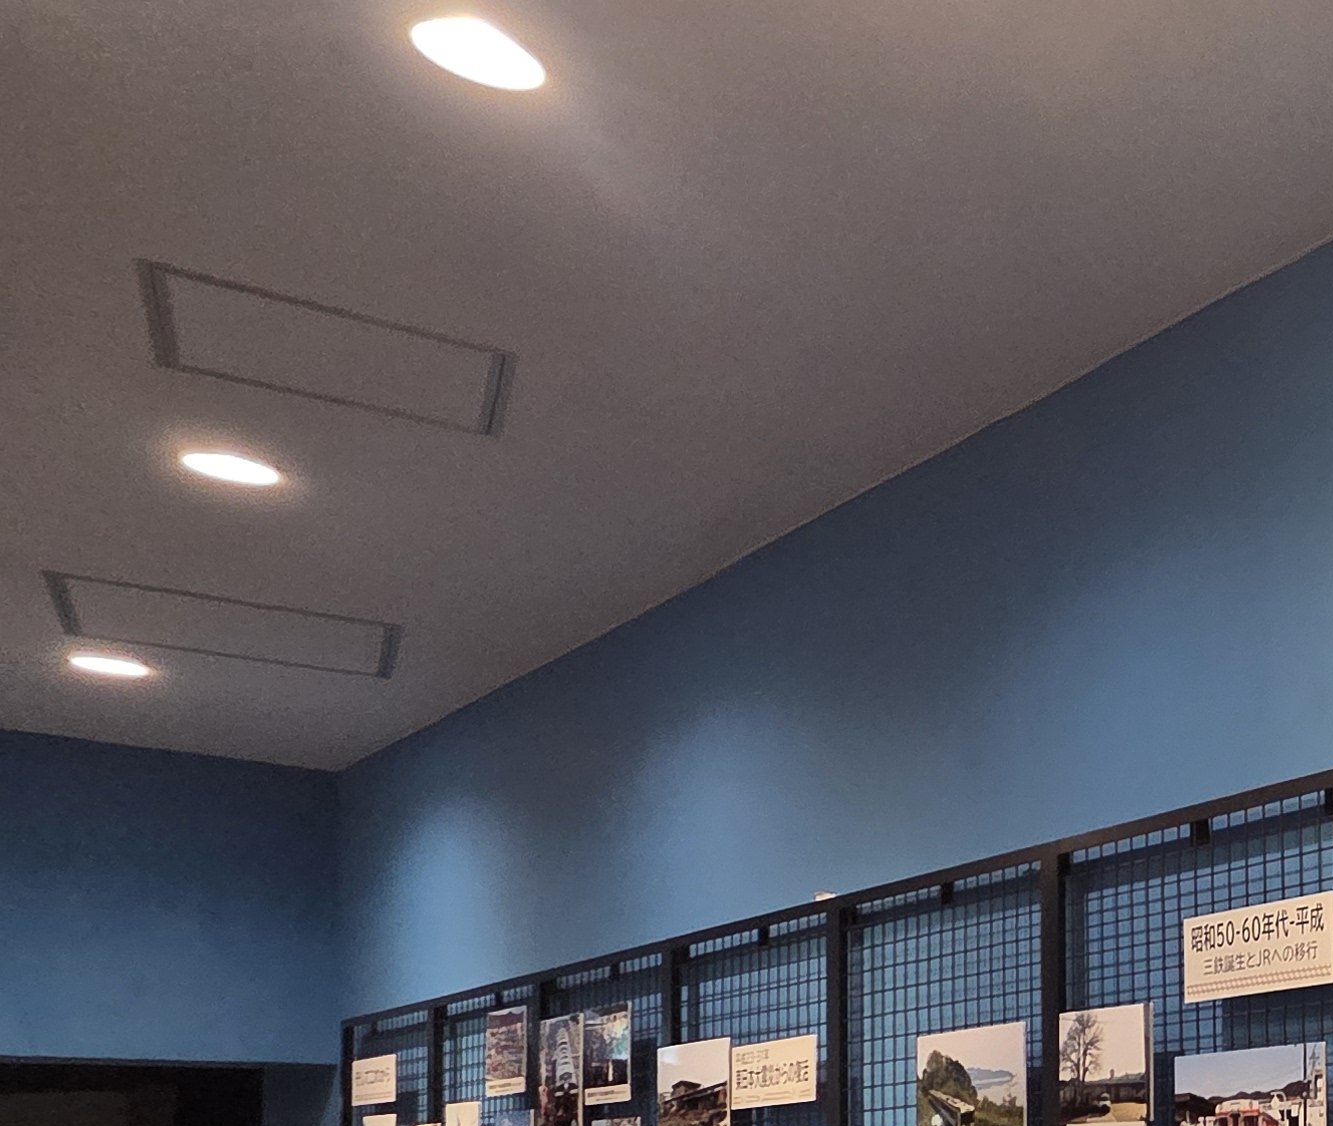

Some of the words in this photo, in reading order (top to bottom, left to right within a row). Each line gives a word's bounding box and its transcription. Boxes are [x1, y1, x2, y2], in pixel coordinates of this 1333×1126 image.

[1191, 903, 1325, 953] 昭和50-60年代-平成
[1203, 940, 1318, 976] 三鉄誕生とJRへの移行
